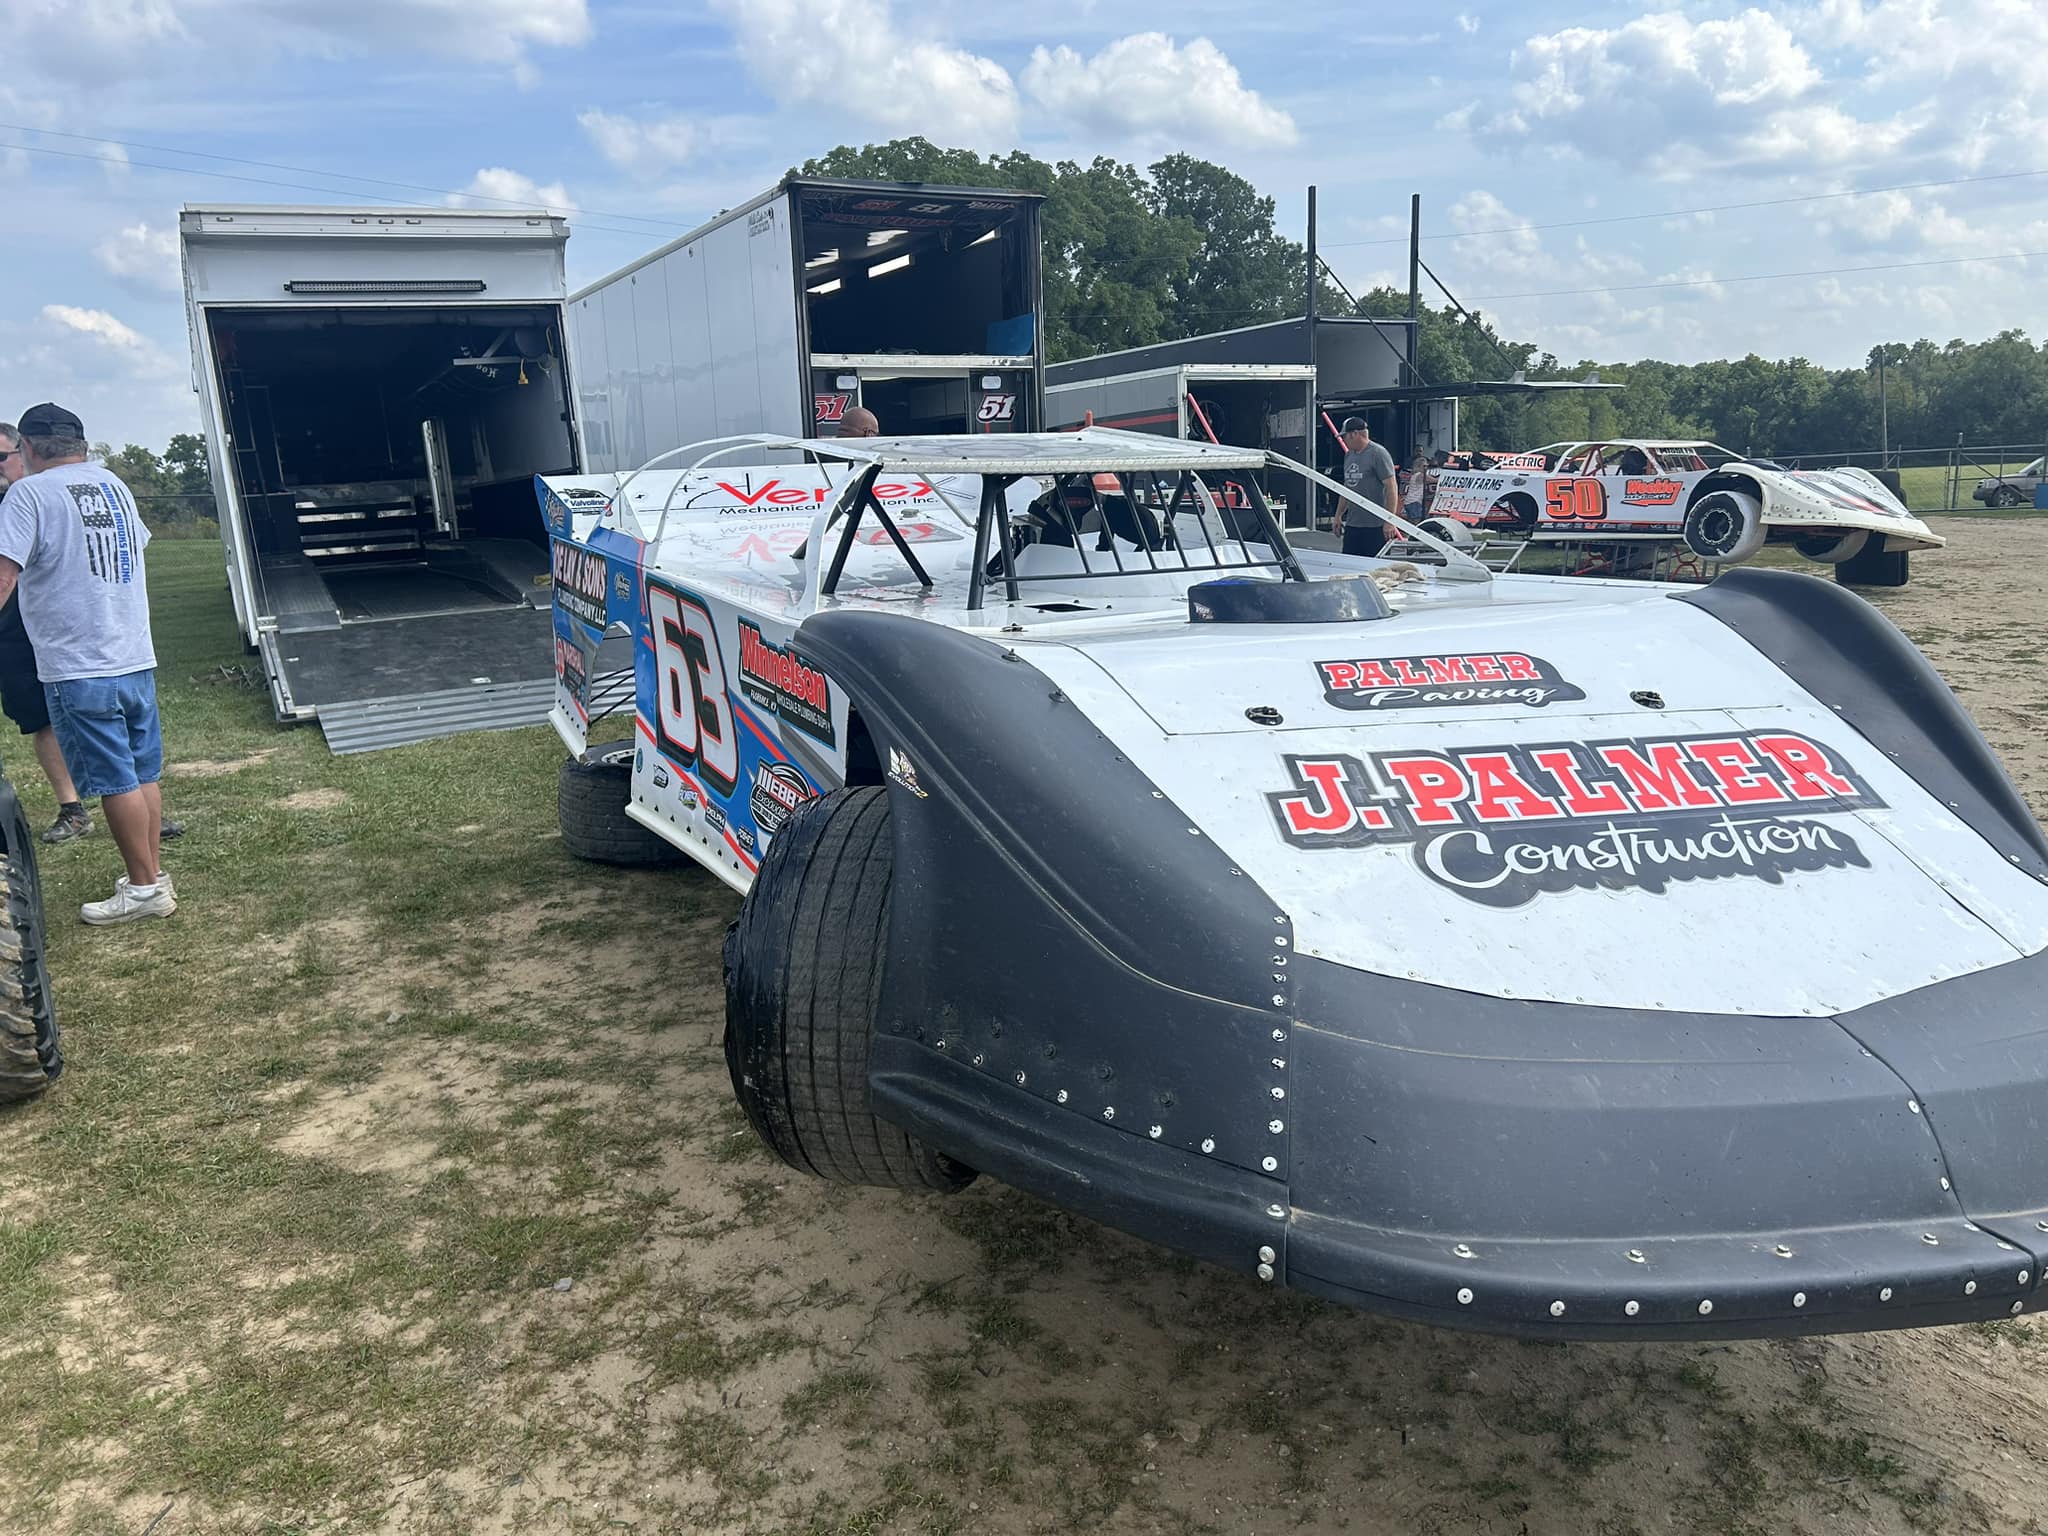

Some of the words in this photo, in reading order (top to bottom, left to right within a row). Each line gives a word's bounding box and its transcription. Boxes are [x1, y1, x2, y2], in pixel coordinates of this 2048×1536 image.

[815, 394, 850, 423] 51
[978, 395, 1016, 423] 51
[715, 479, 934, 506] Verex
[1439, 476, 1473, 490] JACKSON
[1472, 477, 1504, 491] FARMS
[1546, 478, 1604, 518] 50
[79, 494, 107, 516] 84
[570, 499, 605, 507] Valvoline
[719, 503, 821, 515] Mechanical
[913, 496, 939, 505] Inc.
[113, 512, 128, 549] BROOKS
[119, 550, 131, 583] RACING
[582, 555, 607, 600] SONS
[739, 623, 827, 713] Winnelson
[1321, 653, 1543, 690] PALMER
[649, 586, 738, 783] 63
[1353, 685, 1558, 706] Paving
[1424, 812, 1843, 889] Construction
